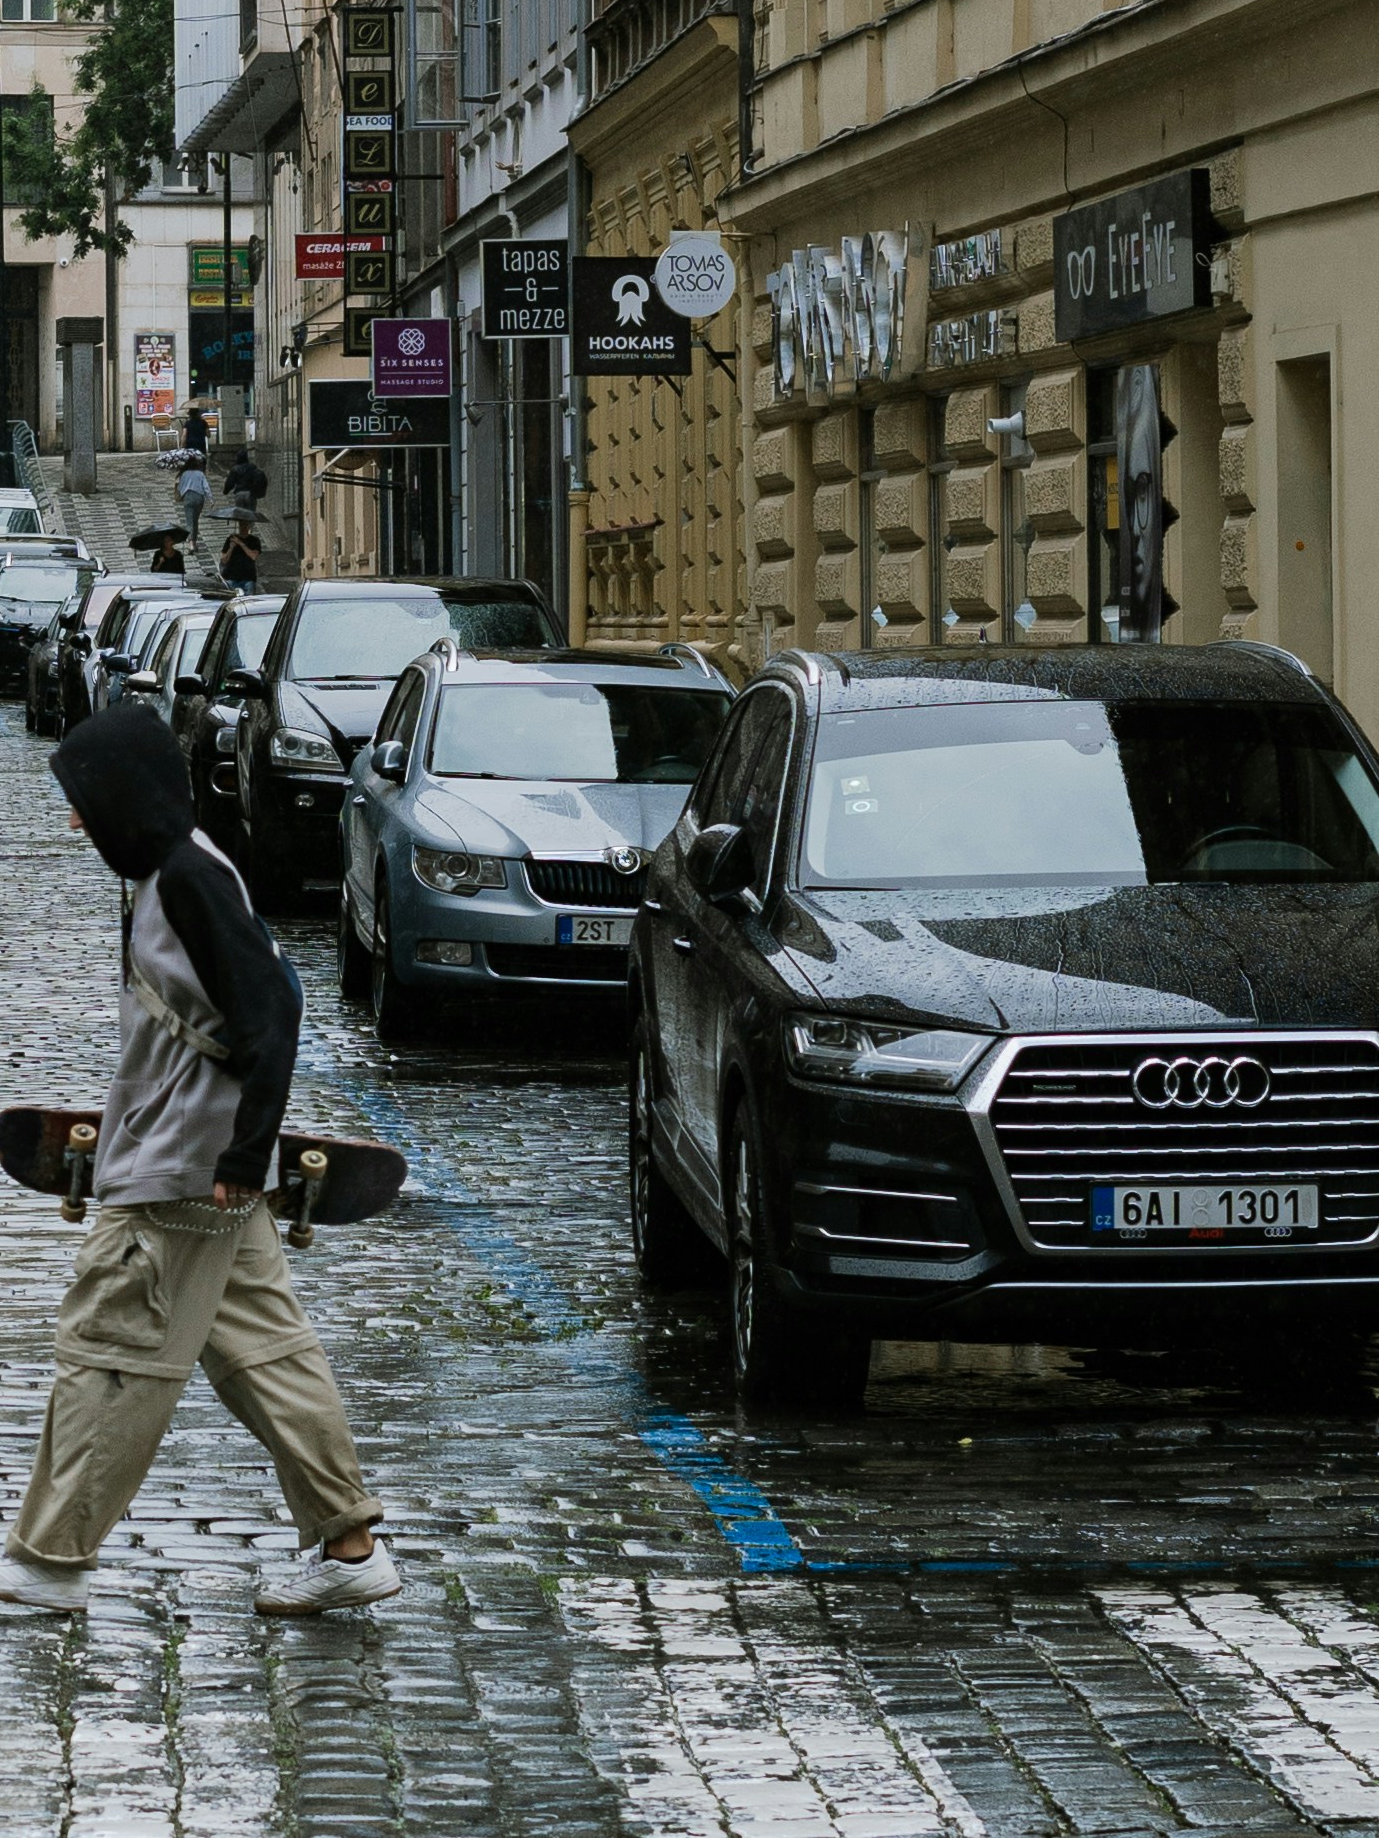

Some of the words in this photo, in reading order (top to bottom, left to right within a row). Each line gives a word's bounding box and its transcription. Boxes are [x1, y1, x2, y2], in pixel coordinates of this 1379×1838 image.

[502, 248, 560, 274] tapas
[666, 254, 725, 272] TOMAS
[525, 277, 538, 302] &
[666, 273, 725, 292] ARSOV
[500, 308, 565, 330] mezze
[589, 336, 675, 350] HOOKAHS
[380, 359, 398, 367] SIX
[401, 359, 444, 367] SENSES
[347, 415, 413, 433] BIBITA
[576, 920, 615, 941] 2ST
[1218, 1188, 1299, 1225] 1301
[1095, 1213, 1113, 1227] CZ
[1188, 1228, 1225, 1239] Audi
